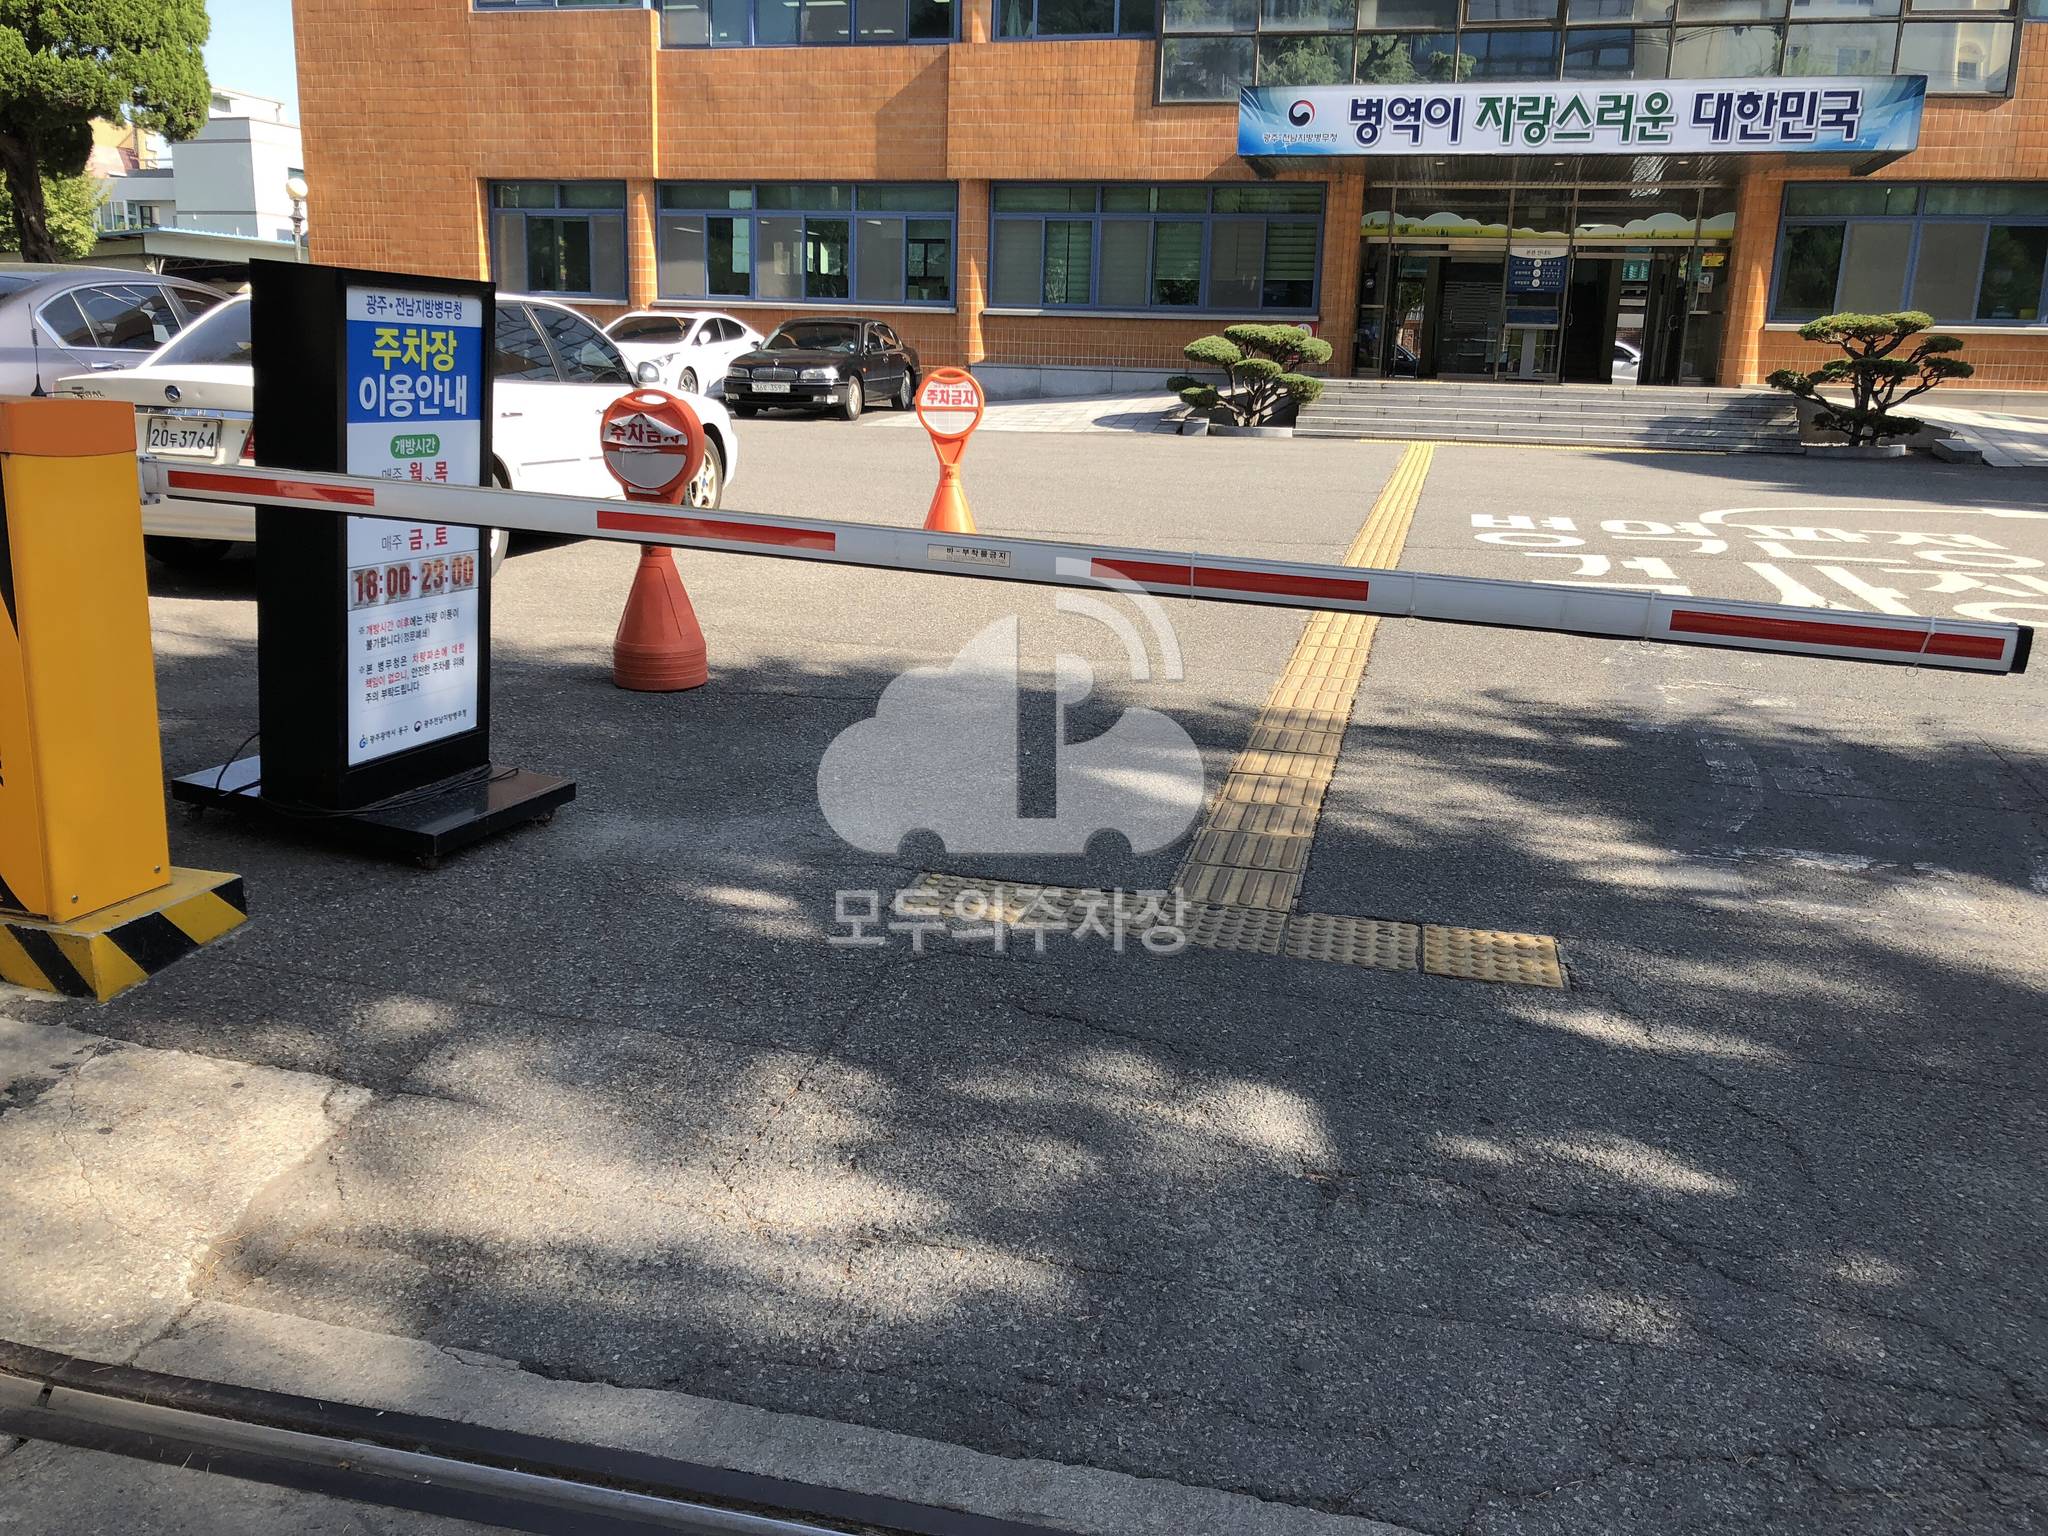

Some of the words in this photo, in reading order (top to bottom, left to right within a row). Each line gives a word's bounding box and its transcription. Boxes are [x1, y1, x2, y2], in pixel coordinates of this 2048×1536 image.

[1348, 94, 1464, 146] 병역이
[1475, 92, 1675, 145] 자랑스러운
[1690, 88, 1862, 143] 대한민국
[372, 326, 459, 373] 주차장
[359, 374, 467, 417] 이용안내
[927, 389, 974, 405] 주차금지
[151, 429, 215, 449] 20두3764
[394, 437, 437, 456] 개방시간
[408, 461, 423, 482] 월
[433, 461, 449, 483] 목
[381, 533, 402, 551] 매주
[433, 526, 449, 546] 토
